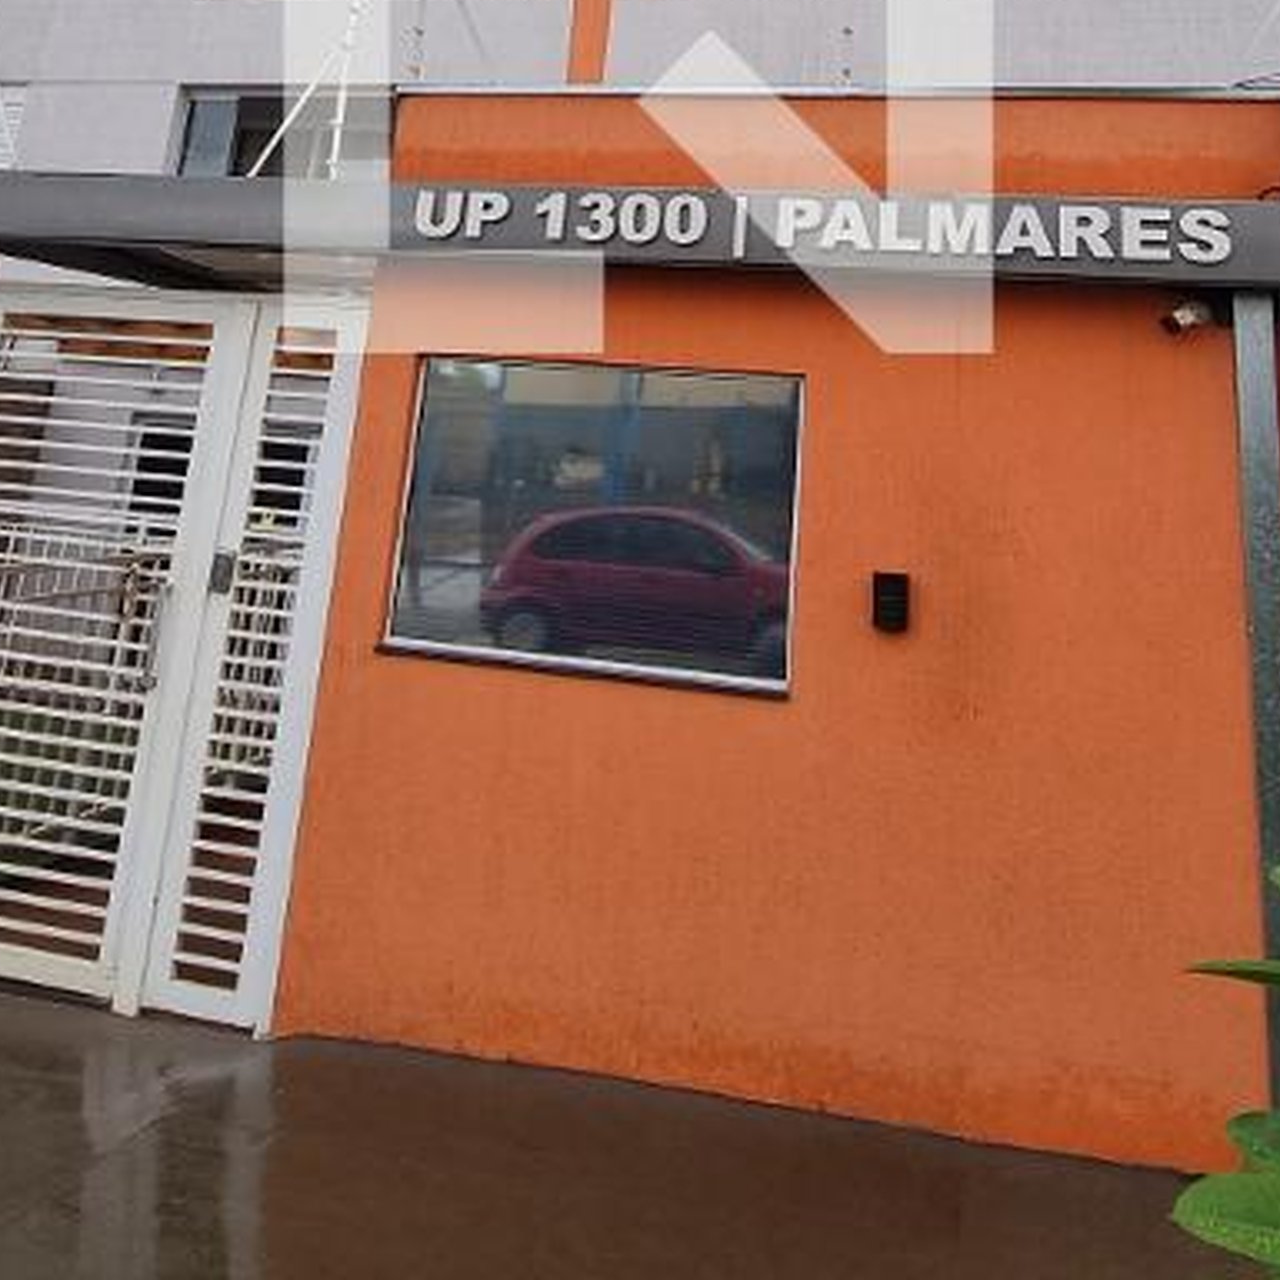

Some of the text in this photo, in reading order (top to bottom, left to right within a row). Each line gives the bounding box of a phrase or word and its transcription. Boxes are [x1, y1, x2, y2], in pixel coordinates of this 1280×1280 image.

[414, 189, 510, 238] UP
[535, 192, 708, 246] 1300
[776, 197, 1233, 264] PALMARES
